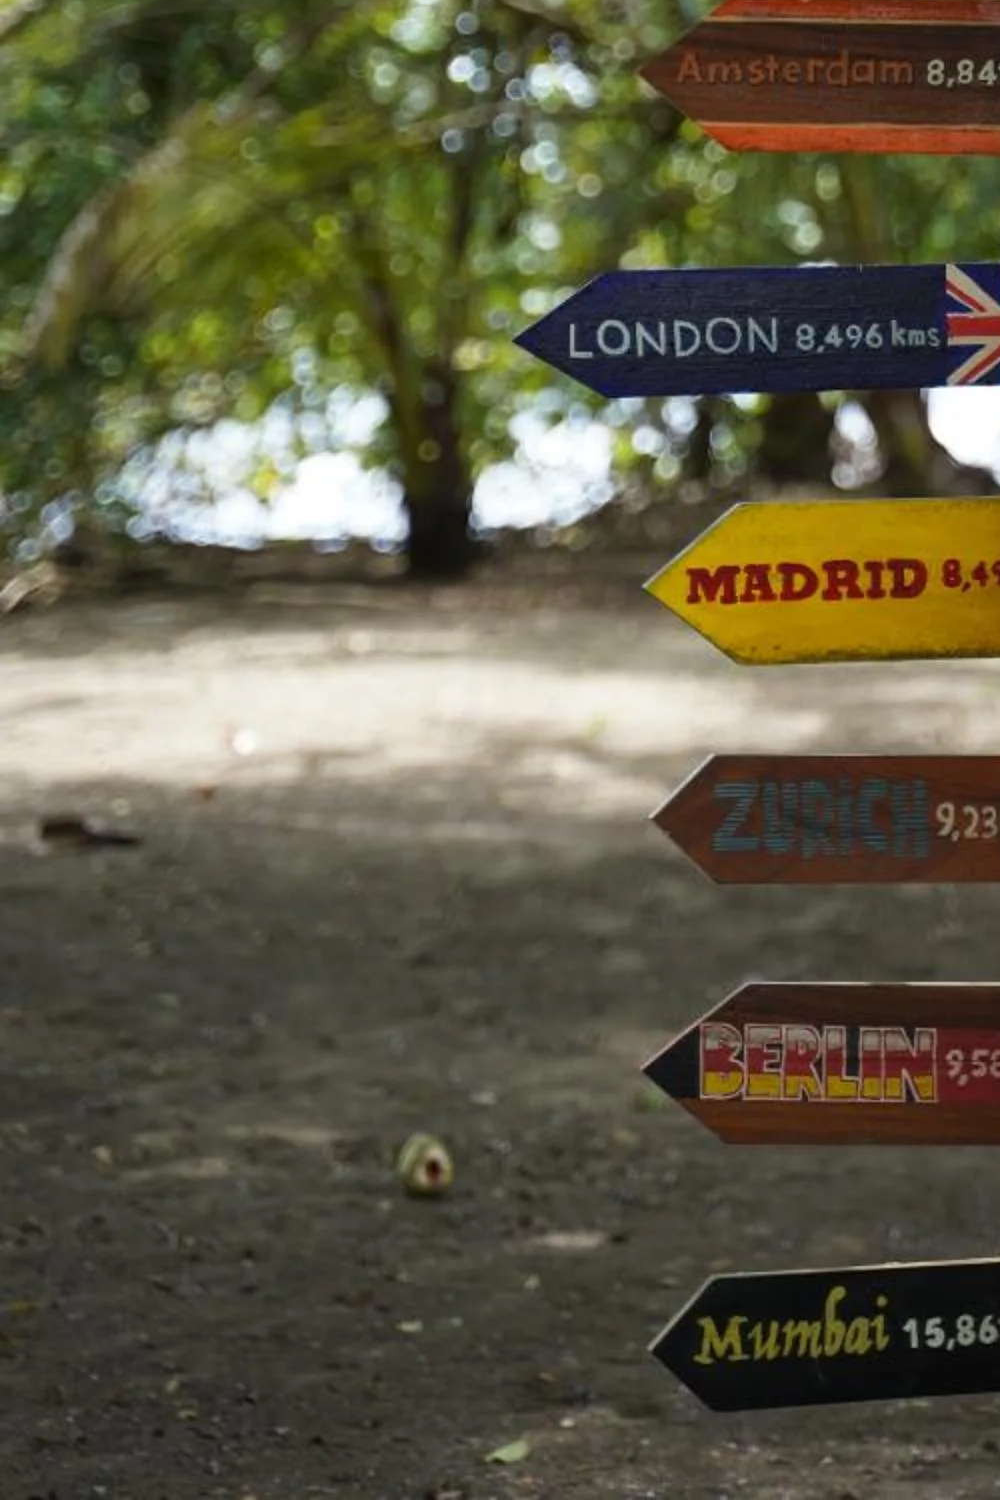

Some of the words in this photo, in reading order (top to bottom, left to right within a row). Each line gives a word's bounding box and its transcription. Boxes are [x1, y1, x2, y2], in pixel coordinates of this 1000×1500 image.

[676, 53, 913, 87] Amsterdam
[568, 317, 778, 359] LONDON
[794, 324, 884, 354] 8,496
[890, 320, 941, 347] kms
[685, 557, 928, 605] MADRID
[711, 779, 931, 858] ZURICH
[699, 1022, 938, 1103] BERLIN
[692, 1285, 890, 1365] Mumbai
